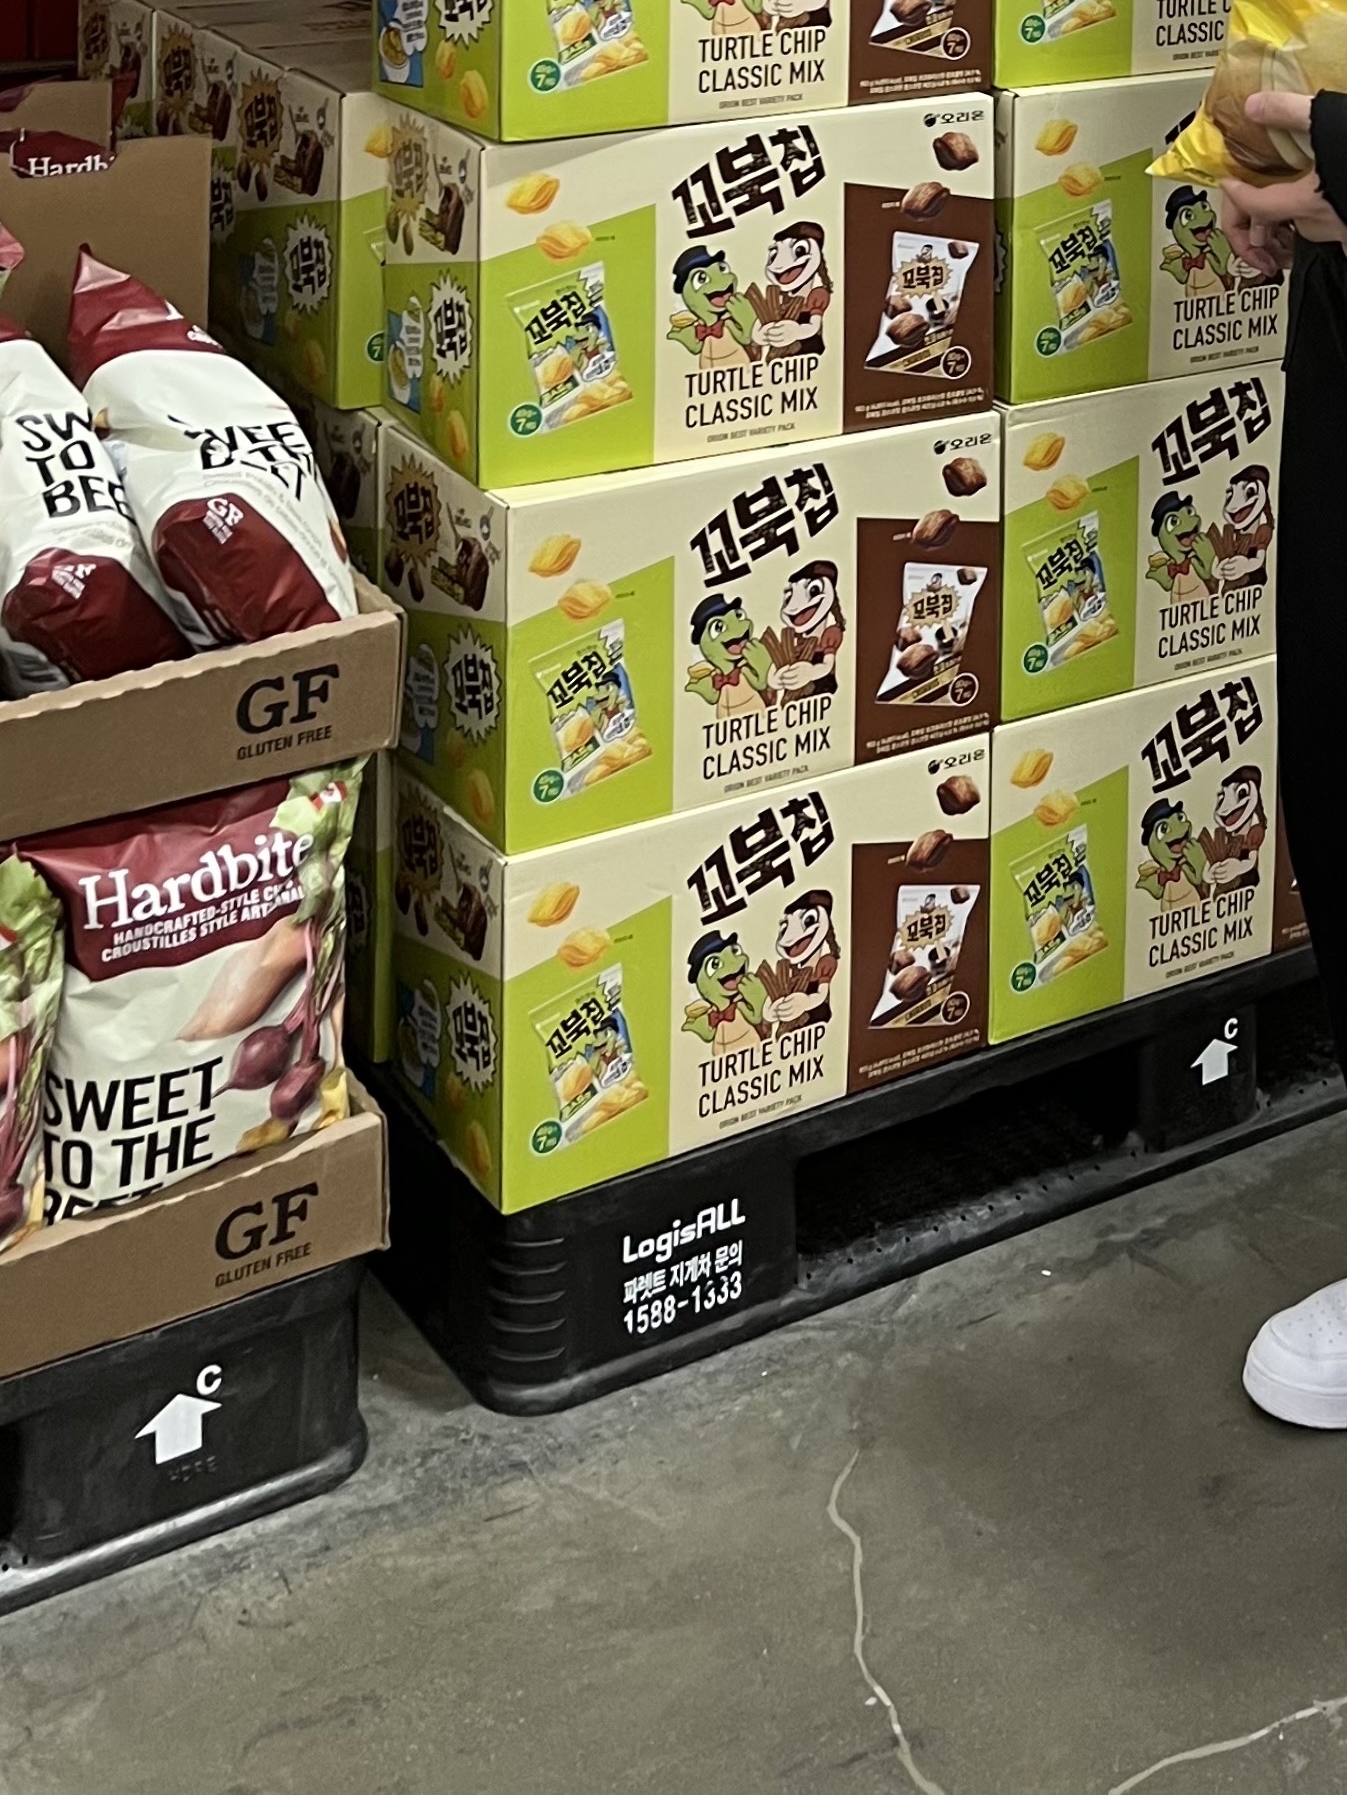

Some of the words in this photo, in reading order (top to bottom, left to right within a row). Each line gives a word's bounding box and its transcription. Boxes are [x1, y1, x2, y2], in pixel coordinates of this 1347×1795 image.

[698, 34, 774, 63] TURTLE
[779, 30, 827, 56] CHIP
[698, 62, 783, 94] CLASSIC
[790, 58, 826, 83] MIX
[940, 109, 985, 126] 오리온
[672, 125, 825, 239] 꼬북칩
[685, 366, 763, 398] TURTLE
[770, 357, 819, 386] CHIP
[685, 396, 773, 429] CLASSIC
[781, 386, 819, 413] MIX
[1151, 377, 1271, 486] 꼬북칩
[26, 440, 96, 488] TO
[690, 462, 839, 588] 꼬북칩
[1159, 596, 1219, 631] TURTLE
[1224, 587, 1263, 613] CHIP
[1158, 623, 1226, 658] CLASSIC
[1231, 614, 1261, 638] MIX
[237, 664, 340, 735] GF
[237, 736, 293, 761] GLUTEN
[298, 726, 333, 750] FREE
[944, 750, 986, 770] 오리온
[1141, 677, 1263, 794] 꼬북칩
[78, 830, 314, 931] Hardbite
[686, 791, 834, 926] 꼬북칩
[101, 928, 196, 964] CROUSTILLES
[199, 915, 237, 945] STYLE
[1149, 901, 1210, 939] TURTLE
[1216, 889, 1254, 918] CHIP
[1148, 927, 1218, 968] CLASSIC
[1223, 916, 1254, 943] MIX
[1224, 1017, 1238, 1039] C
[698, 1046, 775, 1087] TURTLE
[779, 1026, 827, 1061] CHIP
[43, 1057, 223, 1132] SWEET
[697, 1071, 784, 1118] CLASSIC
[790, 1056, 826, 1086] MIX
[43, 1136, 93, 1189] TO
[112, 1115, 216, 1182] THE
[215, 1181, 319, 1260] GF
[622, 1198, 746, 1264] LogisALL
[215, 1254, 271, 1288] GLUTEN
[274, 1243, 312, 1271] FREE
[623, 1269, 667, 1305] 파렛트
[669, 1251, 711, 1287] 지게차
[715, 1239, 743, 1274] 문의
[624, 1270, 743, 1334] 1588-1333
[197, 1364, 221, 1395] C
